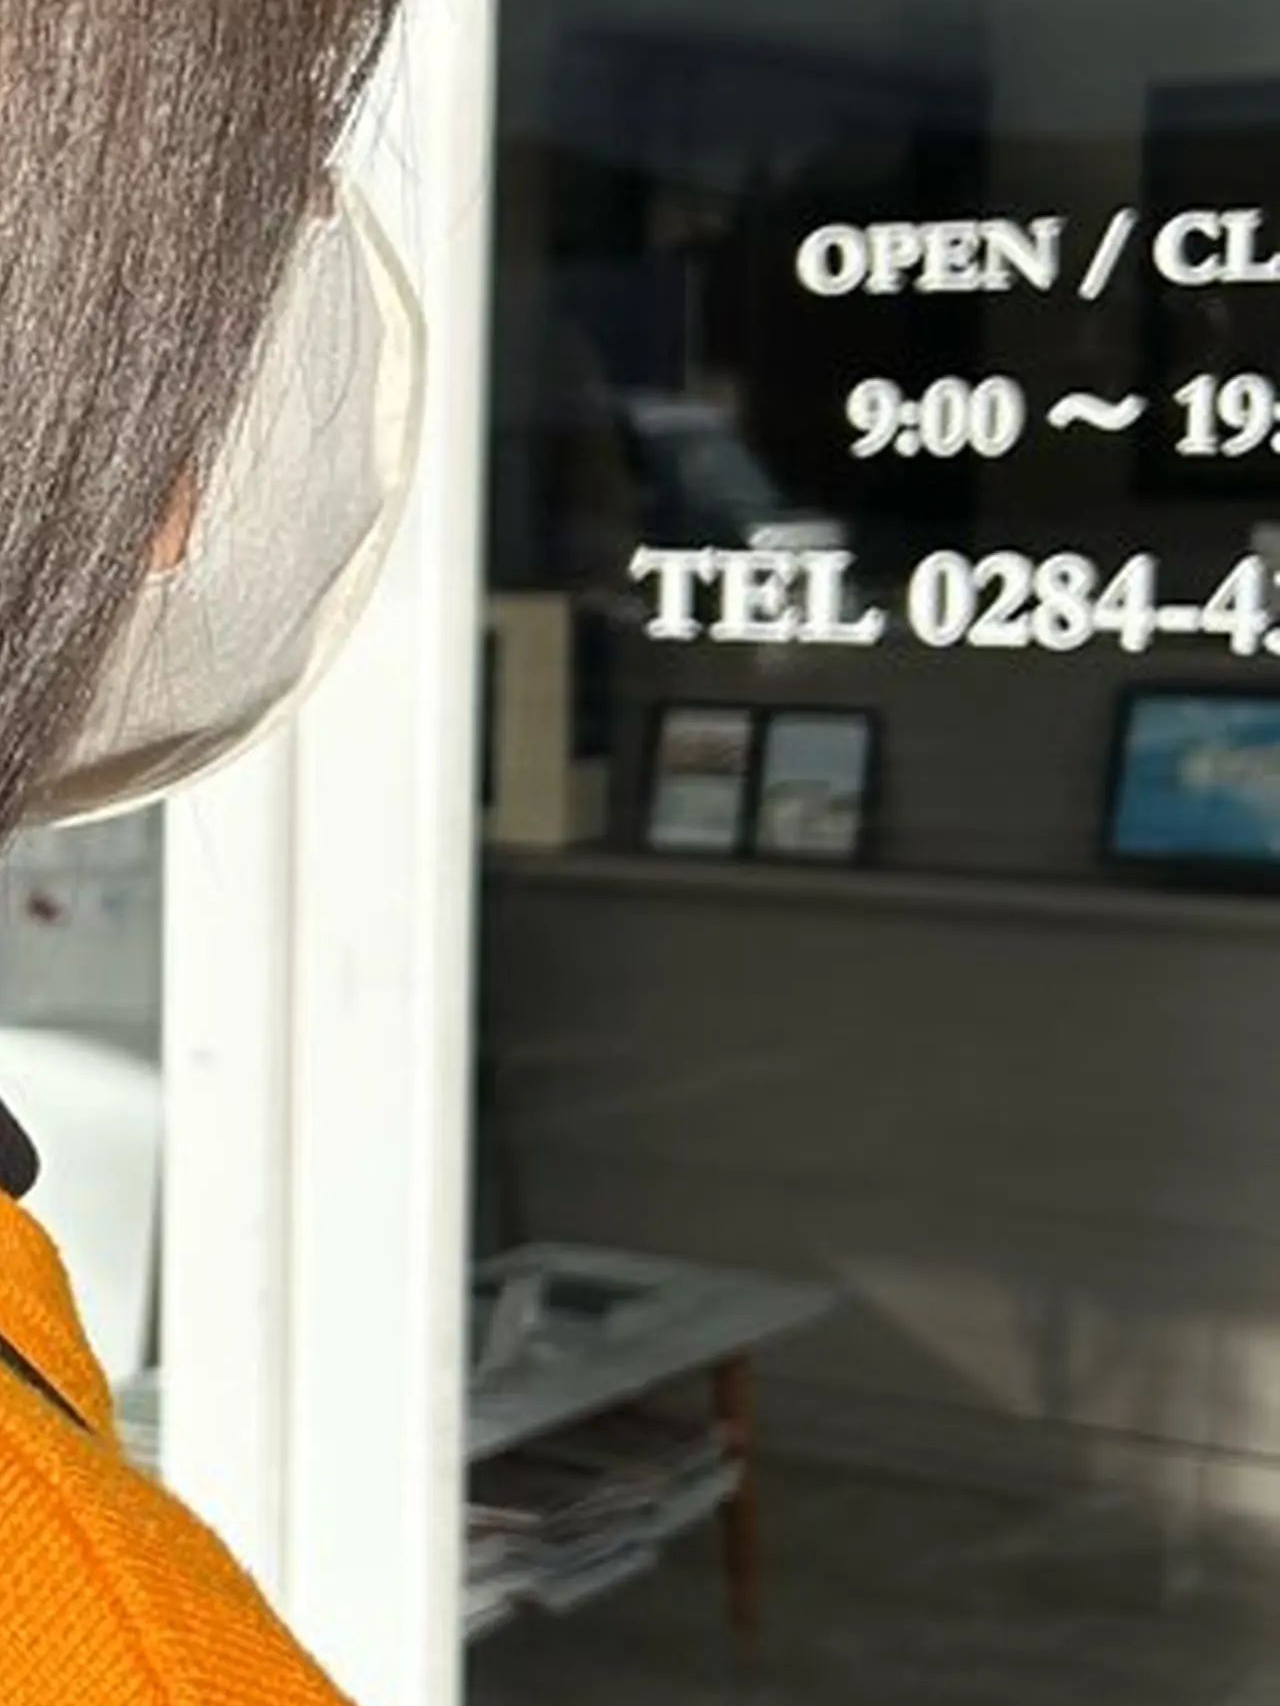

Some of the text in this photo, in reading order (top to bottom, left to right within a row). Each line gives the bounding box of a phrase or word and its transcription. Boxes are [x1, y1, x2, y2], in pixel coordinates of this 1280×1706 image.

[796, 216, 1064, 295] OPEN
[1079, 208, 1135, 300] /
[845, 375, 1024, 458] 9:00
[628, 545, 886, 645] TEL
